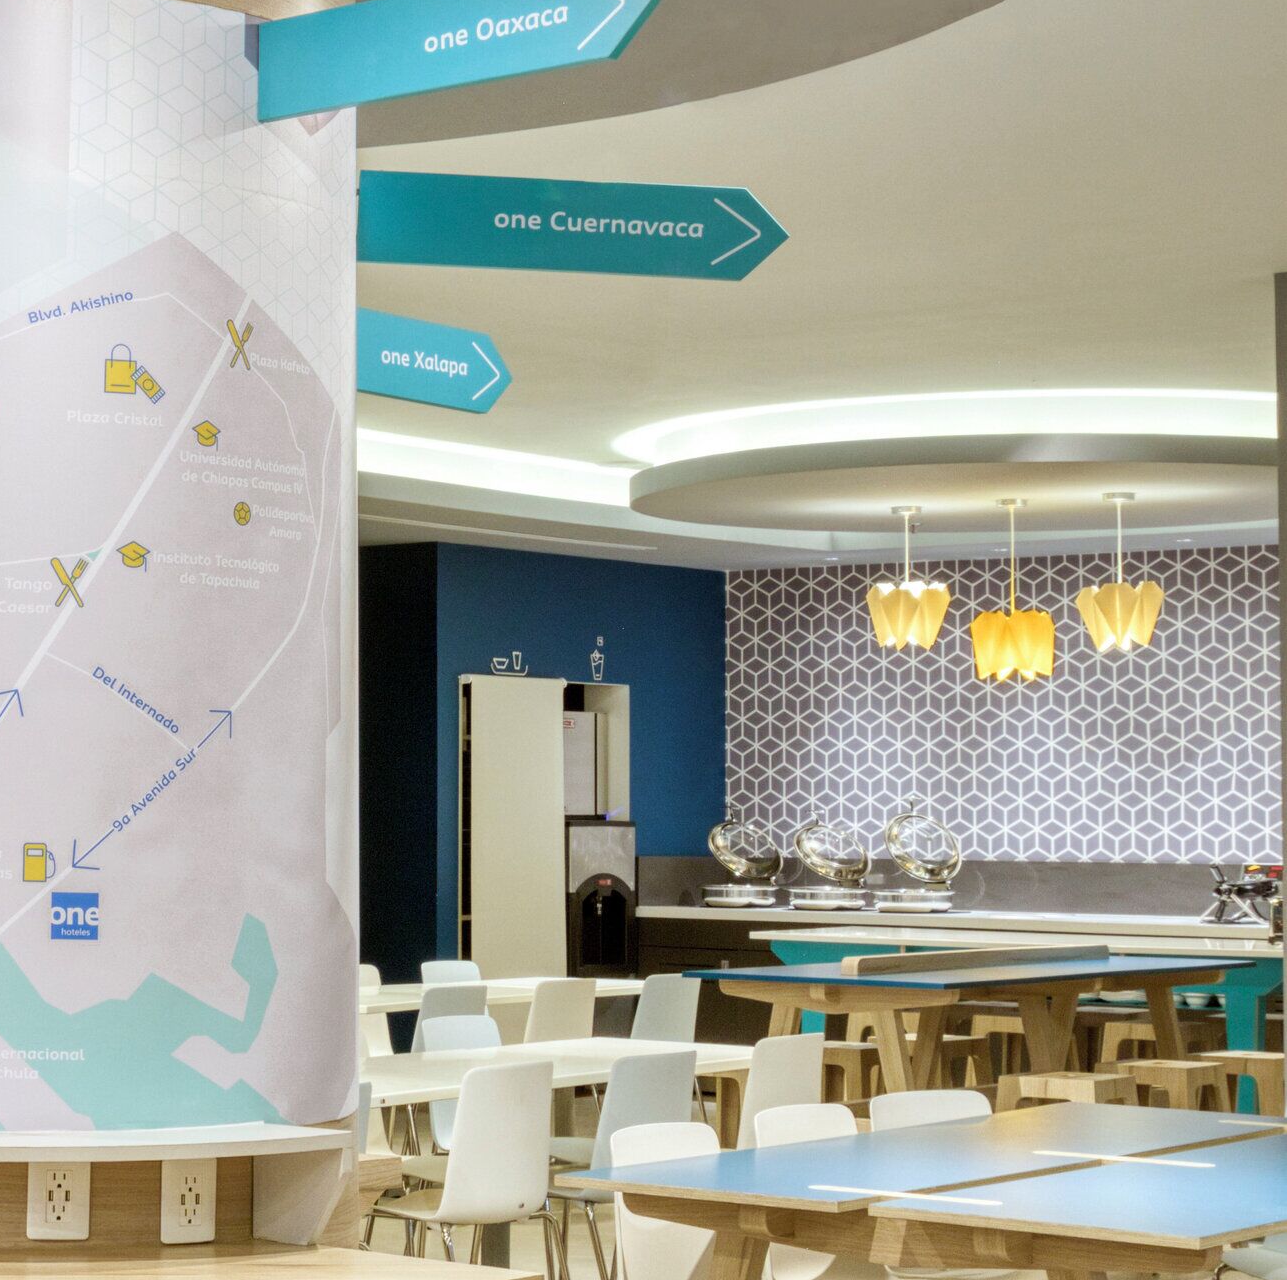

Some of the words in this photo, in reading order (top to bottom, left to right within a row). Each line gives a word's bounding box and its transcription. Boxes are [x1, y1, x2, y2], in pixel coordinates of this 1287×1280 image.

[424, 28, 468, 53] one
[476, 5, 569, 41] Oaxaca
[494, 212, 542, 230] one
[550, 211, 704, 238] Cuernavaca
[28, 305, 66, 324] Blvd.
[70, 291, 134, 314] Akishino
[250, 352, 278, 368] Plaza
[280, 358, 311, 375] Kafeto
[381, 350, 410, 367] one
[414, 351, 468, 378] Xalapa
[66, 410, 109, 424] Plaza
[114, 412, 163, 426] Cristal
[179, 450, 253, 469] Universidad
[254, 458, 306, 477] Autónoma
[181, 469, 199, 482] de
[201, 471, 249, 488] Chiapas
[251, 477, 293, 494] Campus
[293, 483, 305, 495] IV
[153, 551, 211, 567] Instituto
[215, 554, 280, 575] Tecnológico
[4, 578, 53, 593] Tango
[179, 572, 196, 584] de
[200, 573, 261, 590] Tapachula
[92, 666, 117, 690] Del
[117, 683, 180, 734] Internado
[112, 814, 132, 833] 9a
[130, 768, 178, 816] Avenida
[175, 747, 198, 772] Sur
[50, 905, 99, 926] one
[61, 928, 91, 937] hoteles
